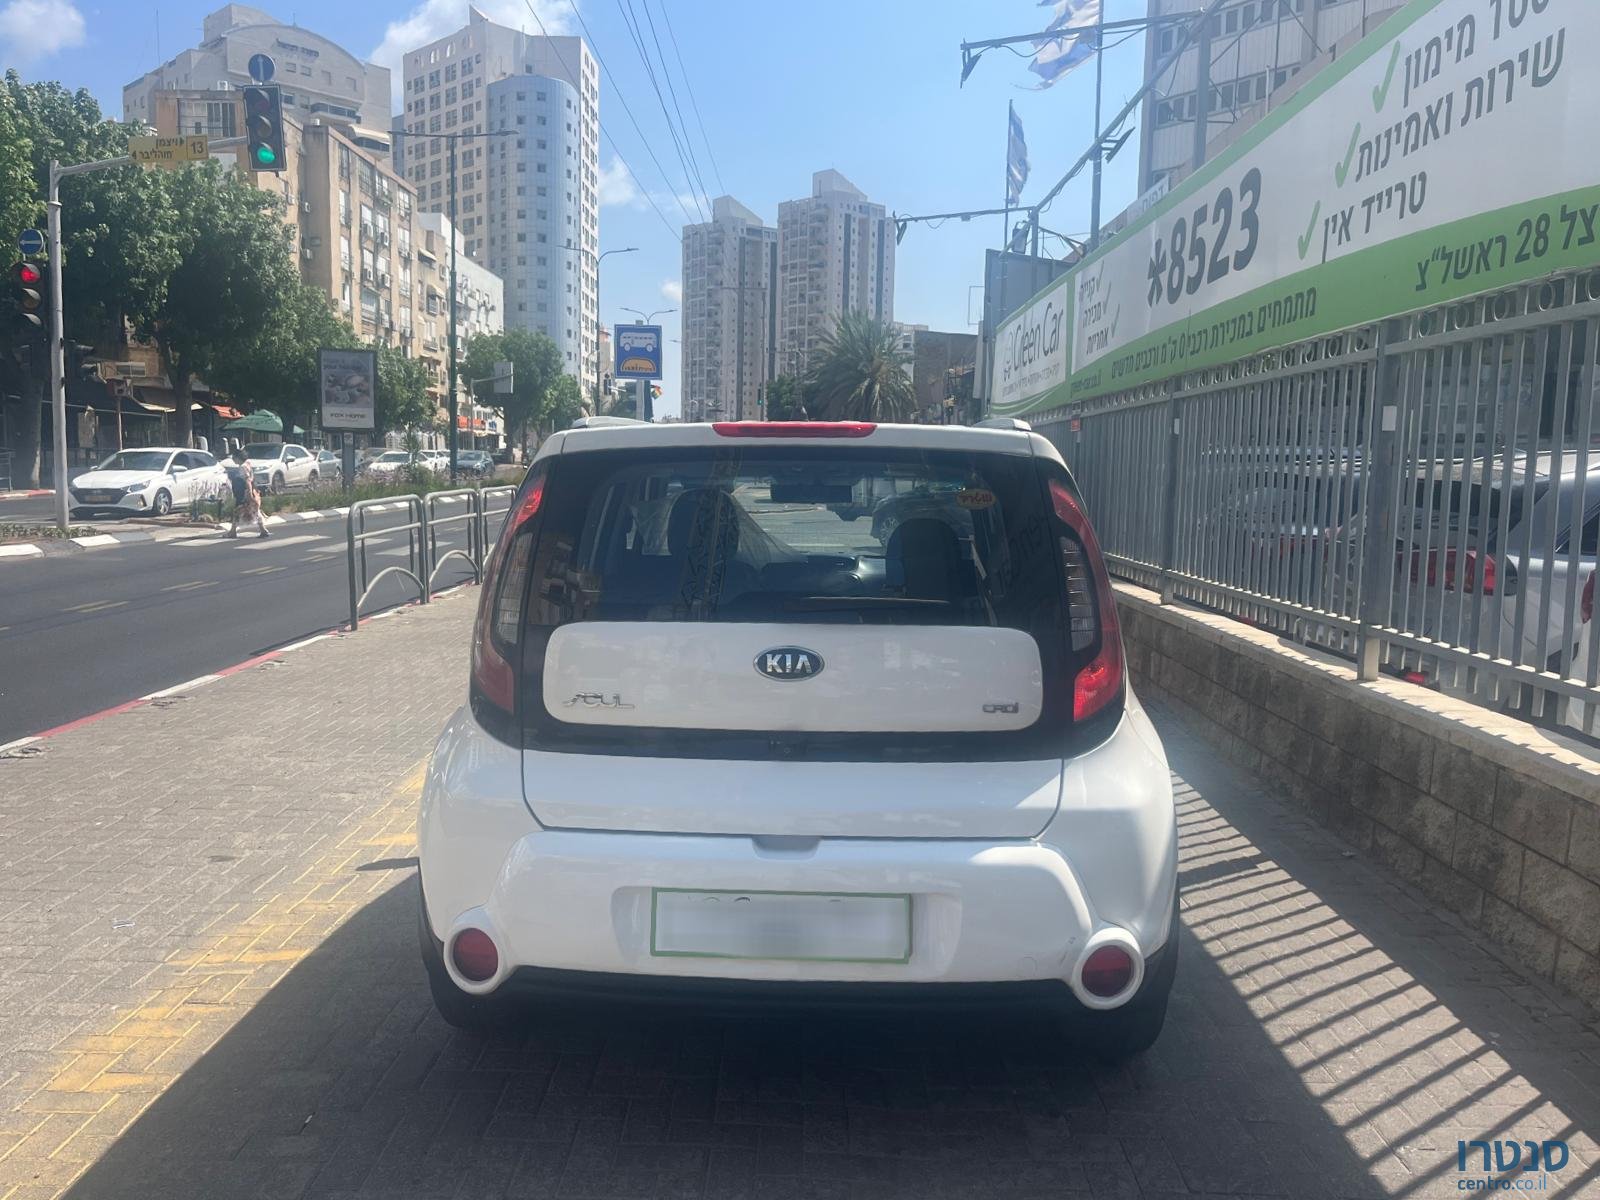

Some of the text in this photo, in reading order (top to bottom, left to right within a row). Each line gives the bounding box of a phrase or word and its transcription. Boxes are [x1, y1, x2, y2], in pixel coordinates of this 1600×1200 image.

[1403, 14, 1476, 109] מימון
[1355, 27, 1566, 183] שירות ואמינות
[191, 141, 204, 155] 13
[1321, 171, 1428, 264] טרייד אין
[1514, 212, 1551, 264] 28
[1042, 301, 1064, 357] Car
[1082, 301, 1102, 329] מכירה
[1209, 310, 1254, 350] במכירת
[1257, 286, 1317, 334] מתמחים
[766, 653, 812, 674] KIA
